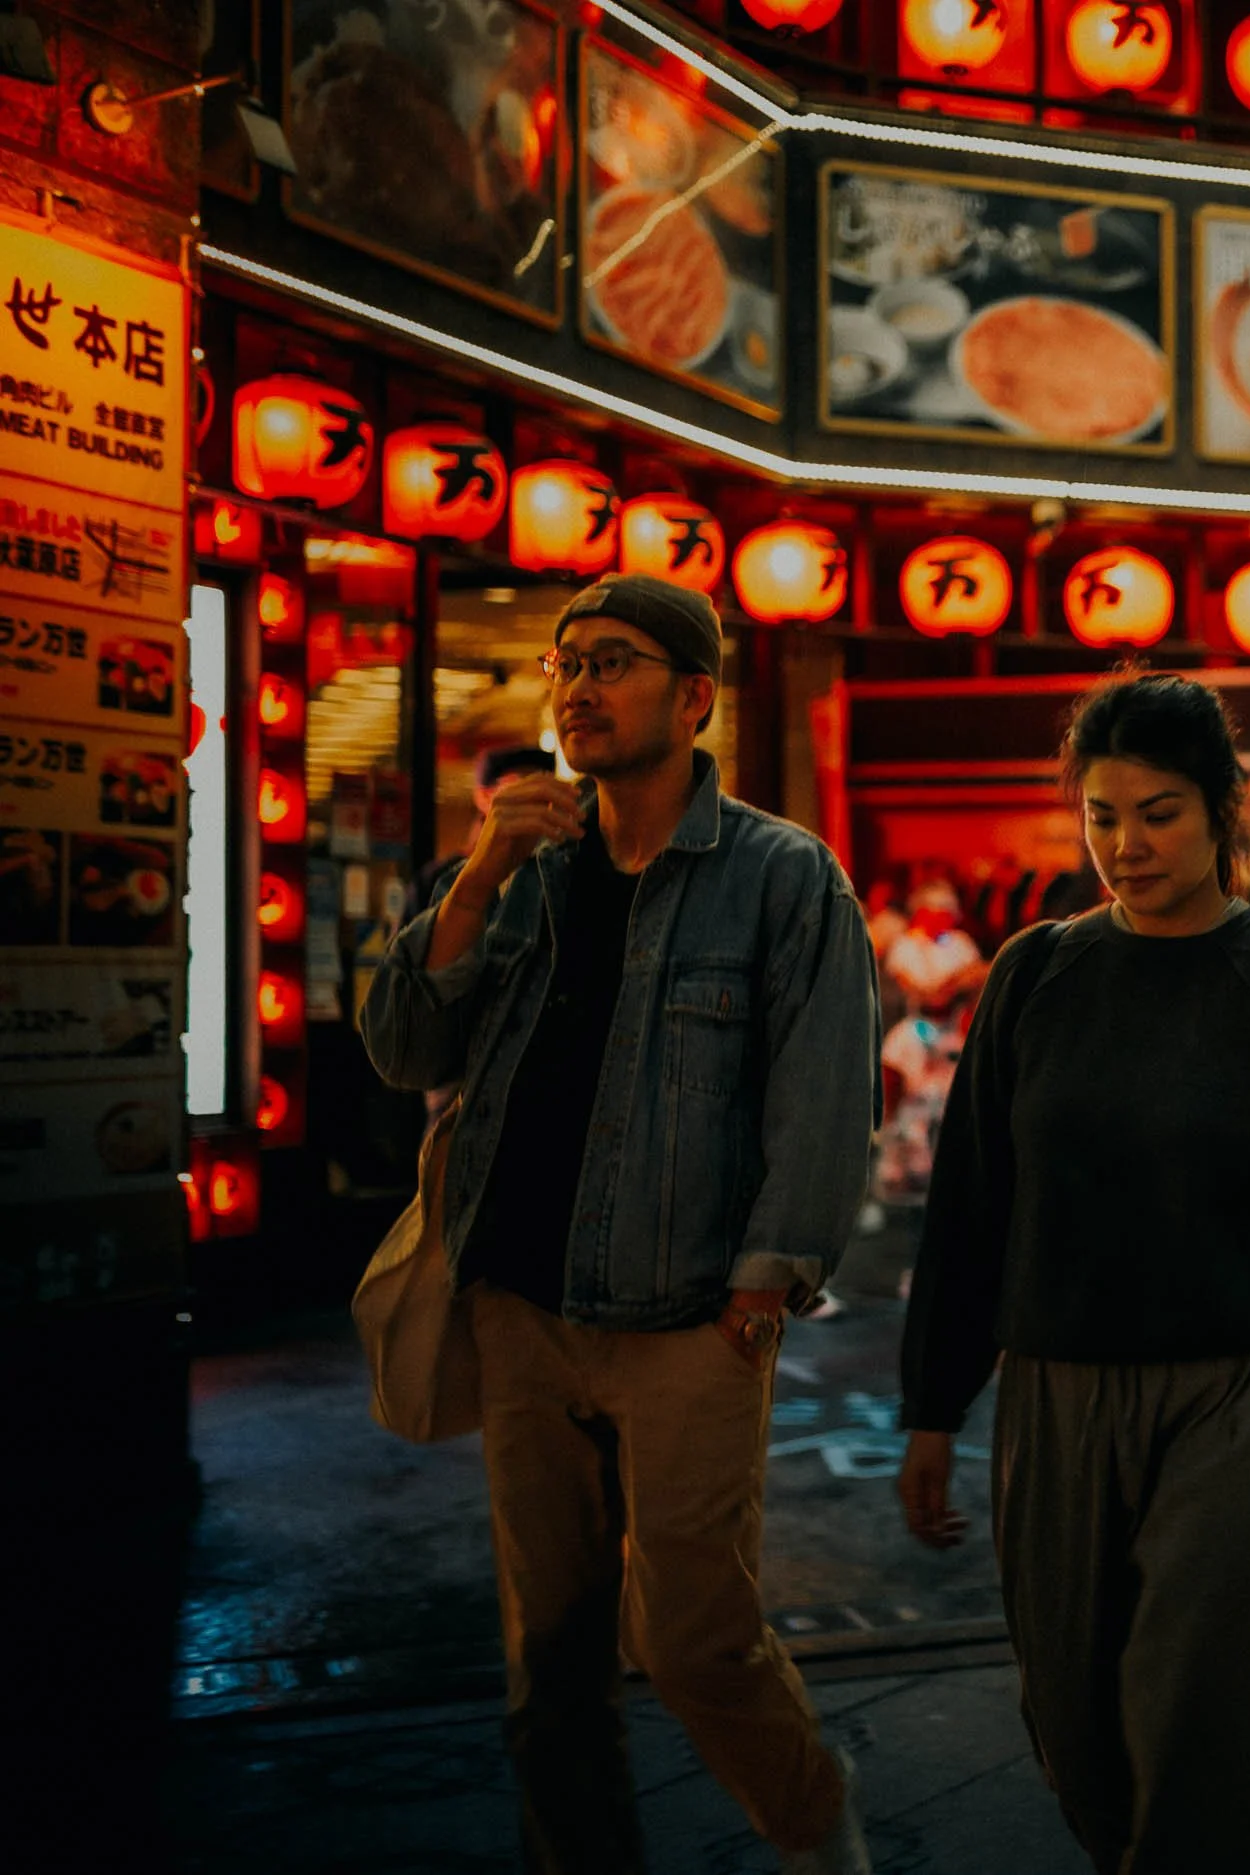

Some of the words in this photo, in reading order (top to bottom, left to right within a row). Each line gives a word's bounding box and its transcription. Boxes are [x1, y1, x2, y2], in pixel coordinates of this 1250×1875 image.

[67, 426, 165, 472] BUILDING
[432, 444, 493, 510] 万
[665, 516, 713, 570] 万
[927, 557, 977, 608] 万
[1080, 560, 1121, 616] 万
